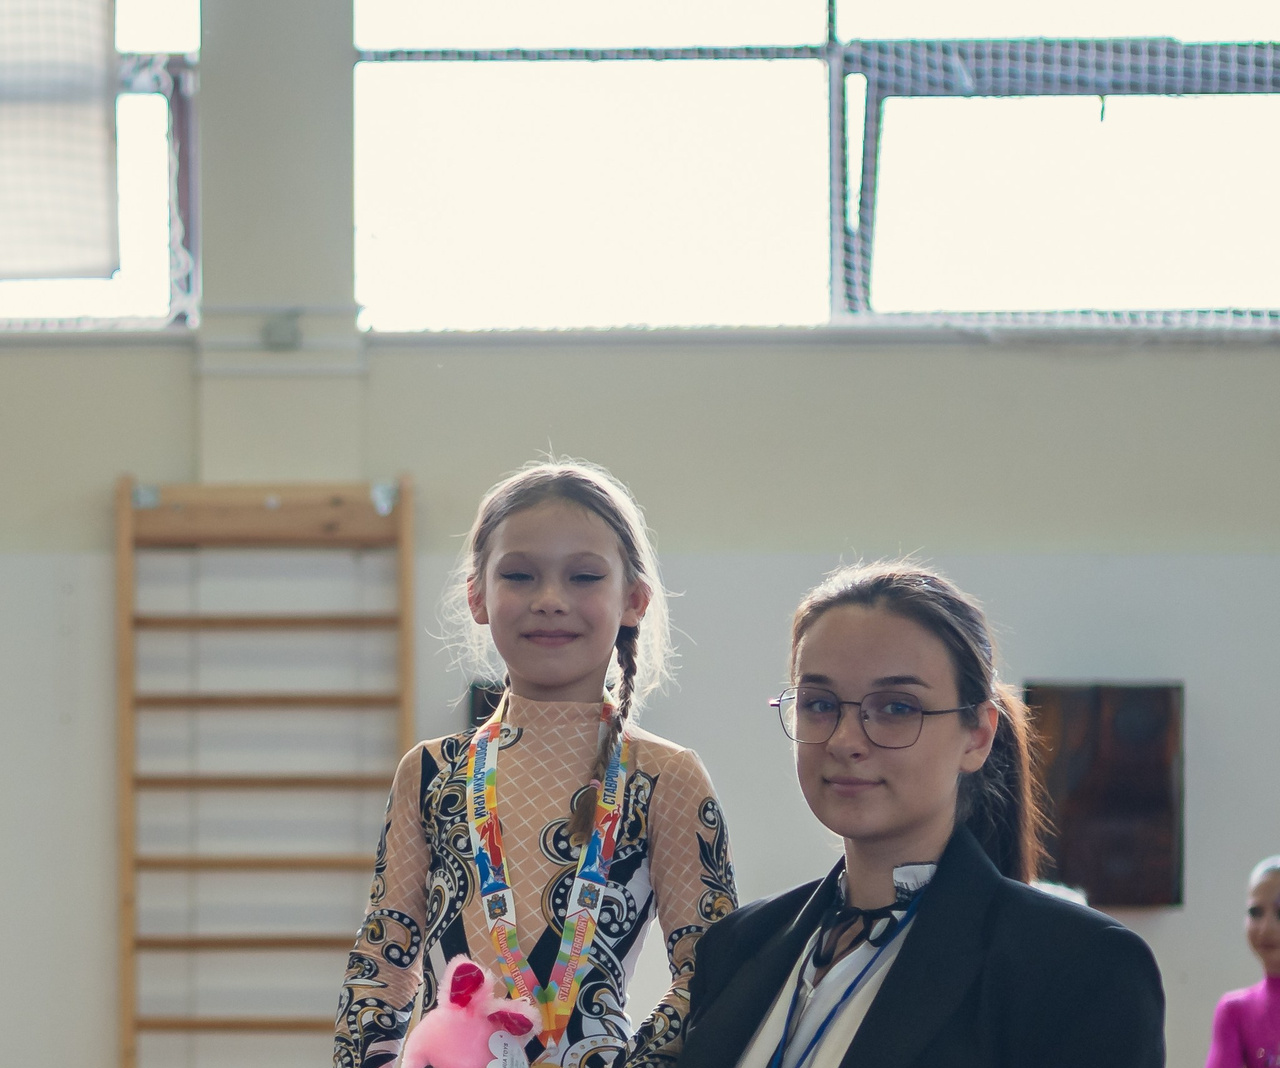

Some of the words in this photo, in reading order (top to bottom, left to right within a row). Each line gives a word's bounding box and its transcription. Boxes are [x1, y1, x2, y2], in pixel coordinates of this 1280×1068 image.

[474, 793, 490, 820] КРАЙ
[497, 925, 514, 970] STAVROPOL
[557, 957, 579, 1002] STAVROPOL
[570, 915, 589, 960] TERRITORY
